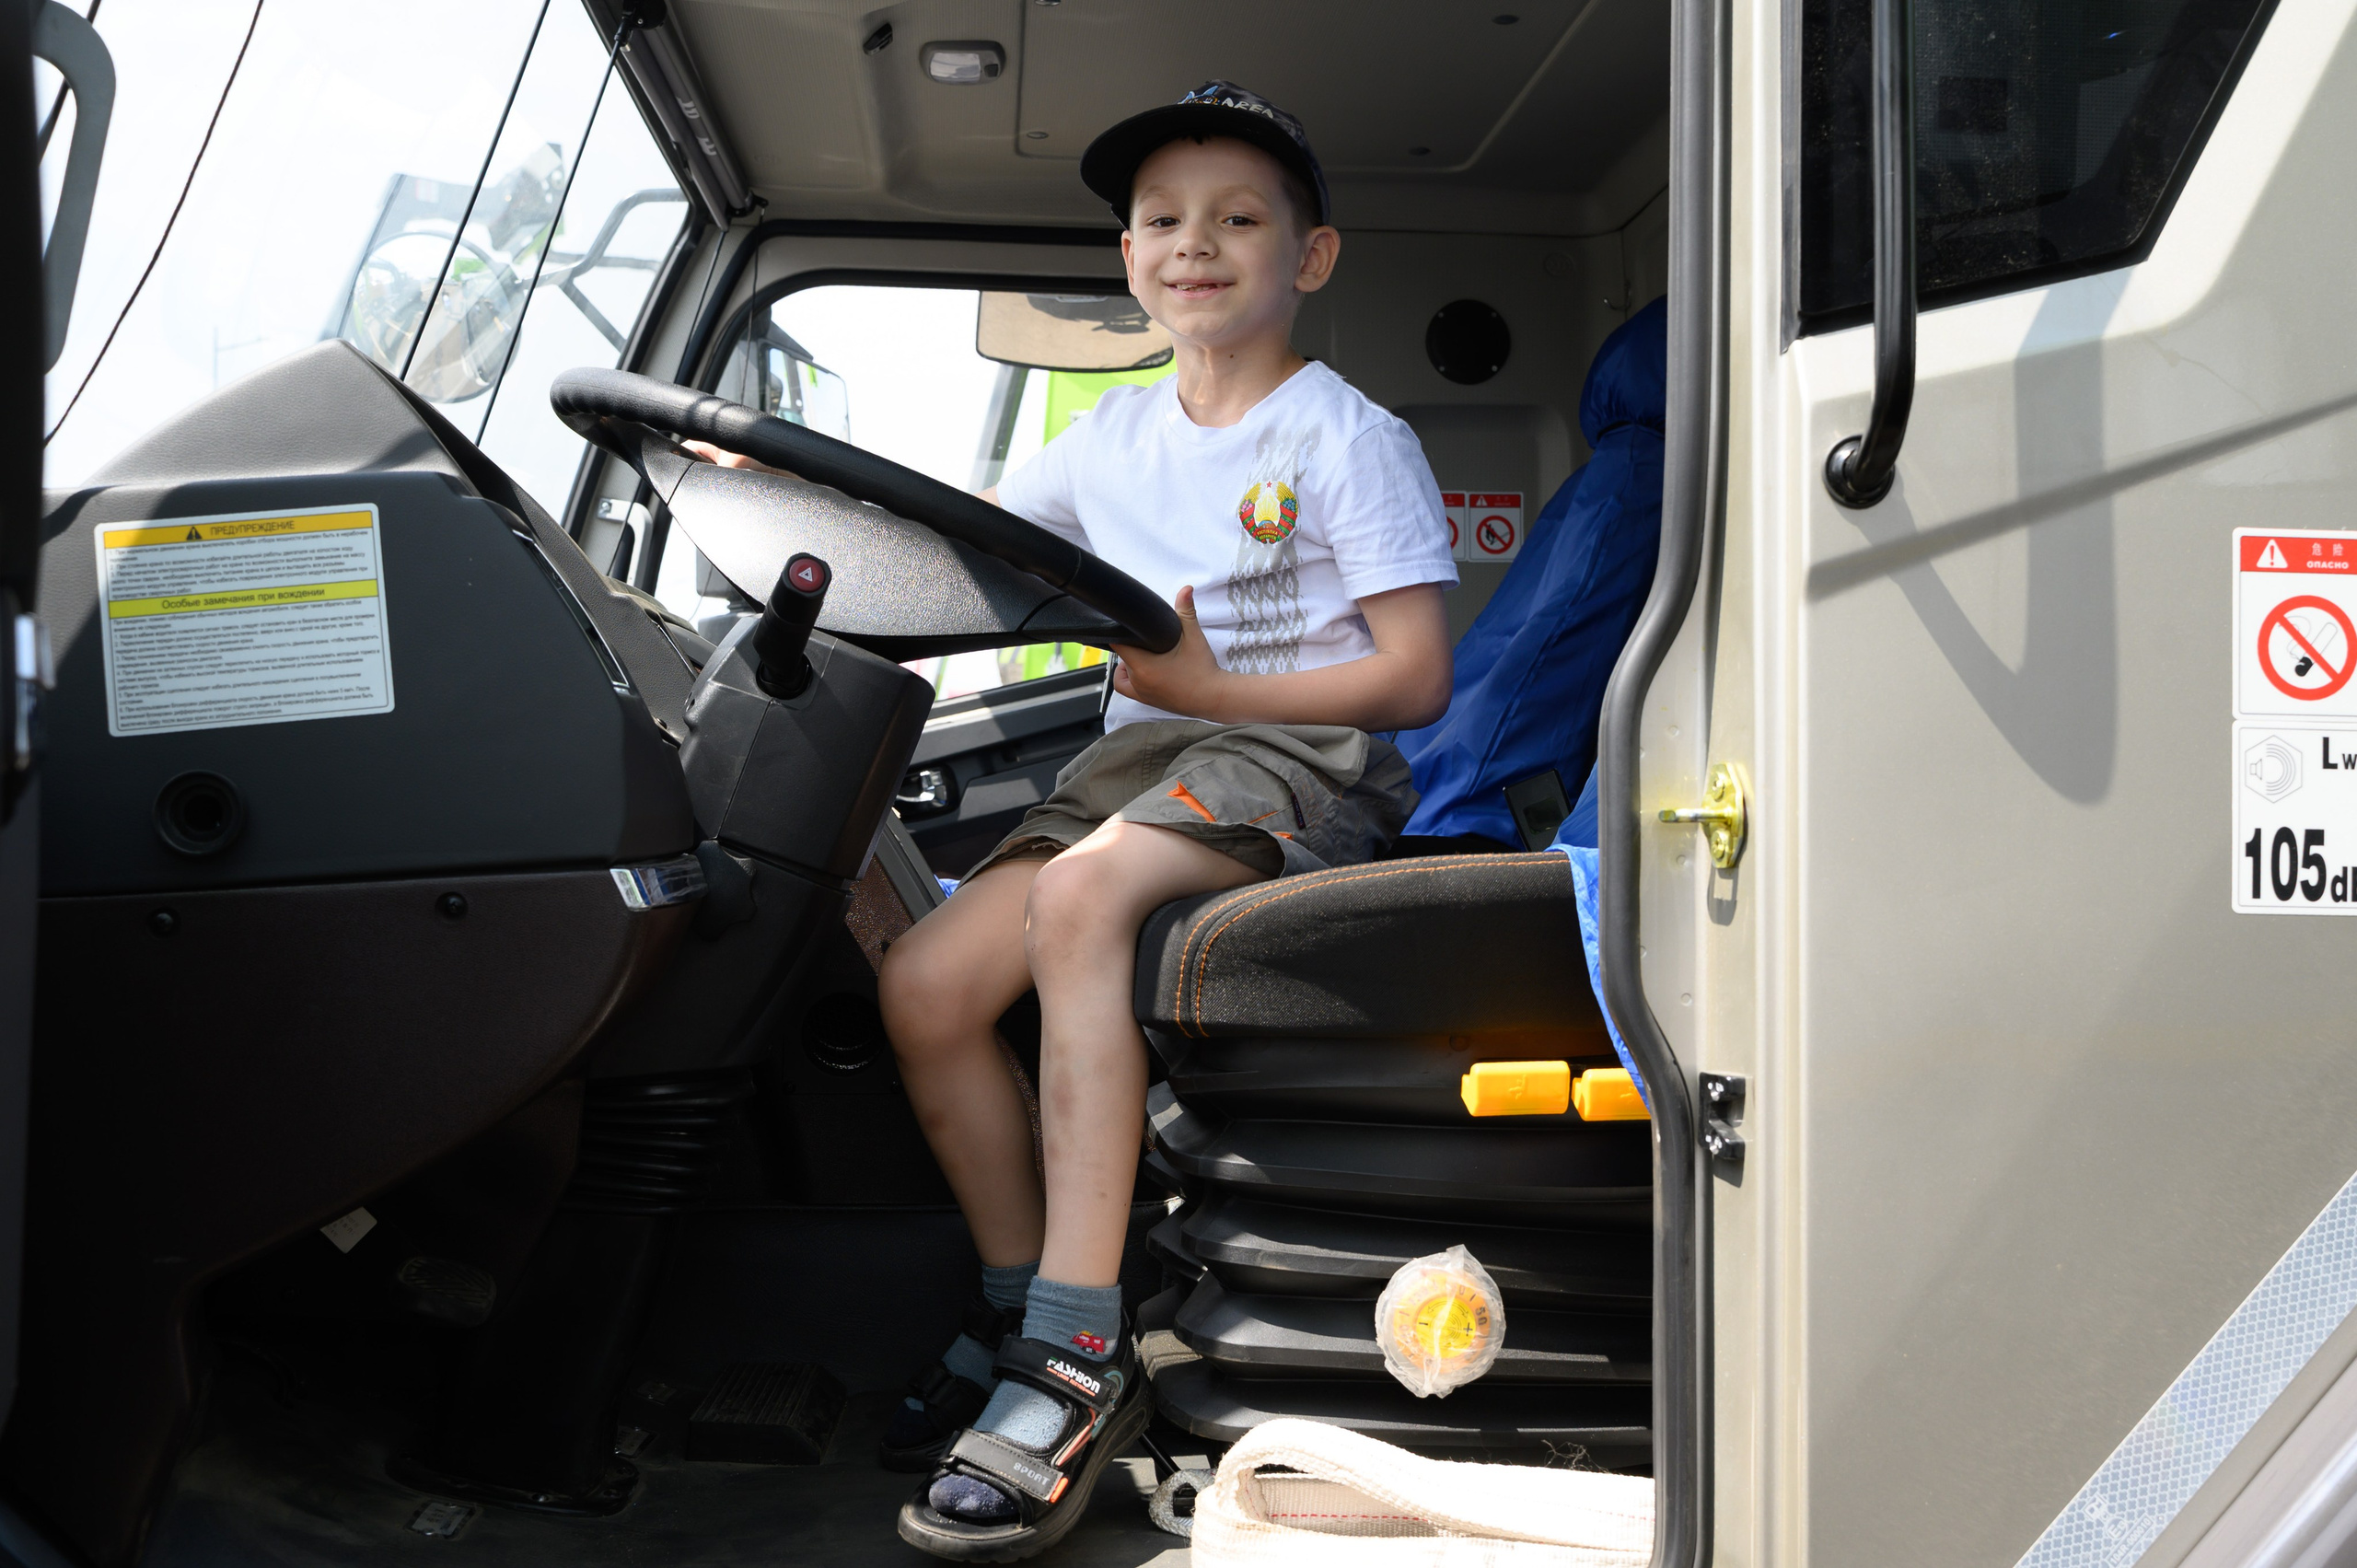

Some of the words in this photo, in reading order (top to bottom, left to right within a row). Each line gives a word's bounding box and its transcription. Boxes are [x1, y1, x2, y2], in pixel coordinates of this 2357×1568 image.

[1221, 97, 1273, 119] AREA
[210, 520, 295, 536] ПРЕДУПРЕЖДЕНИЕ
[2312, 542, 2343, 556] 危险
[2306, 560, 2350, 569] ОПАСНО
[161, 597, 201, 609] Особые
[203, 594, 255, 605] замечания
[257, 592, 274, 602] при
[277, 588, 325, 600] вождении
[1013, 1461, 1051, 1486] SPORT
